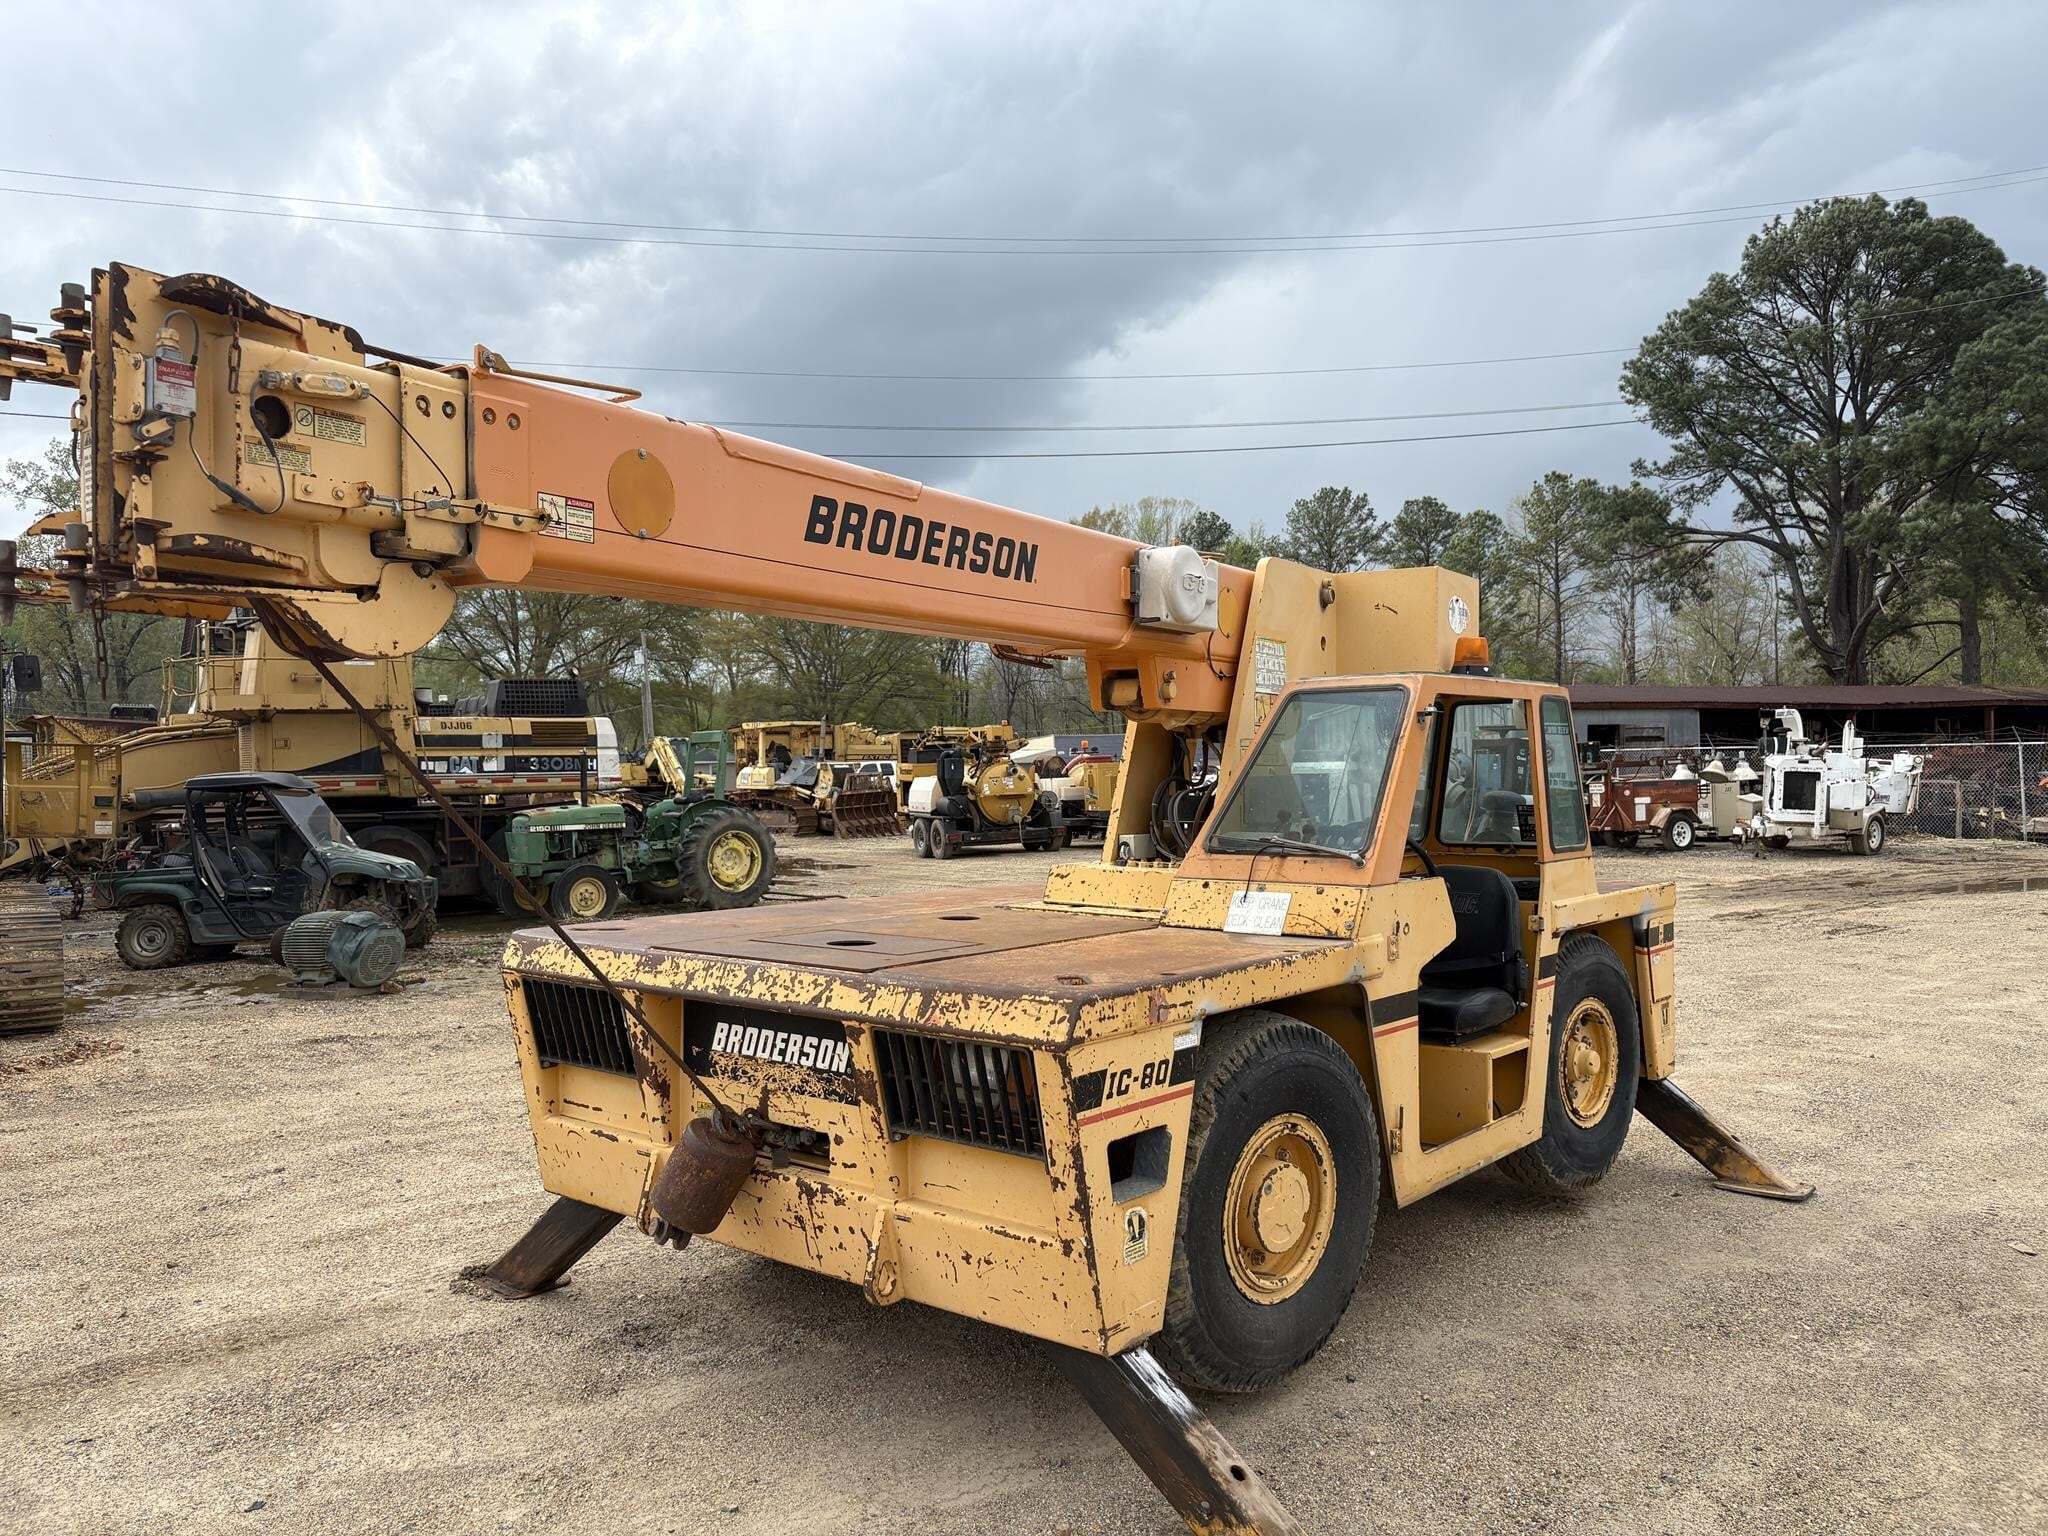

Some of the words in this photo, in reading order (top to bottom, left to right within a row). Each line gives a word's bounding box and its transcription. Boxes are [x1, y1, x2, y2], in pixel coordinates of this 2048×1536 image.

[804, 494, 1039, 583] BRODERSON
[449, 755, 479, 774] CAT
[711, 1021, 851, 1074] BRODERSON
[1106, 1058, 1170, 1100] IC-80
